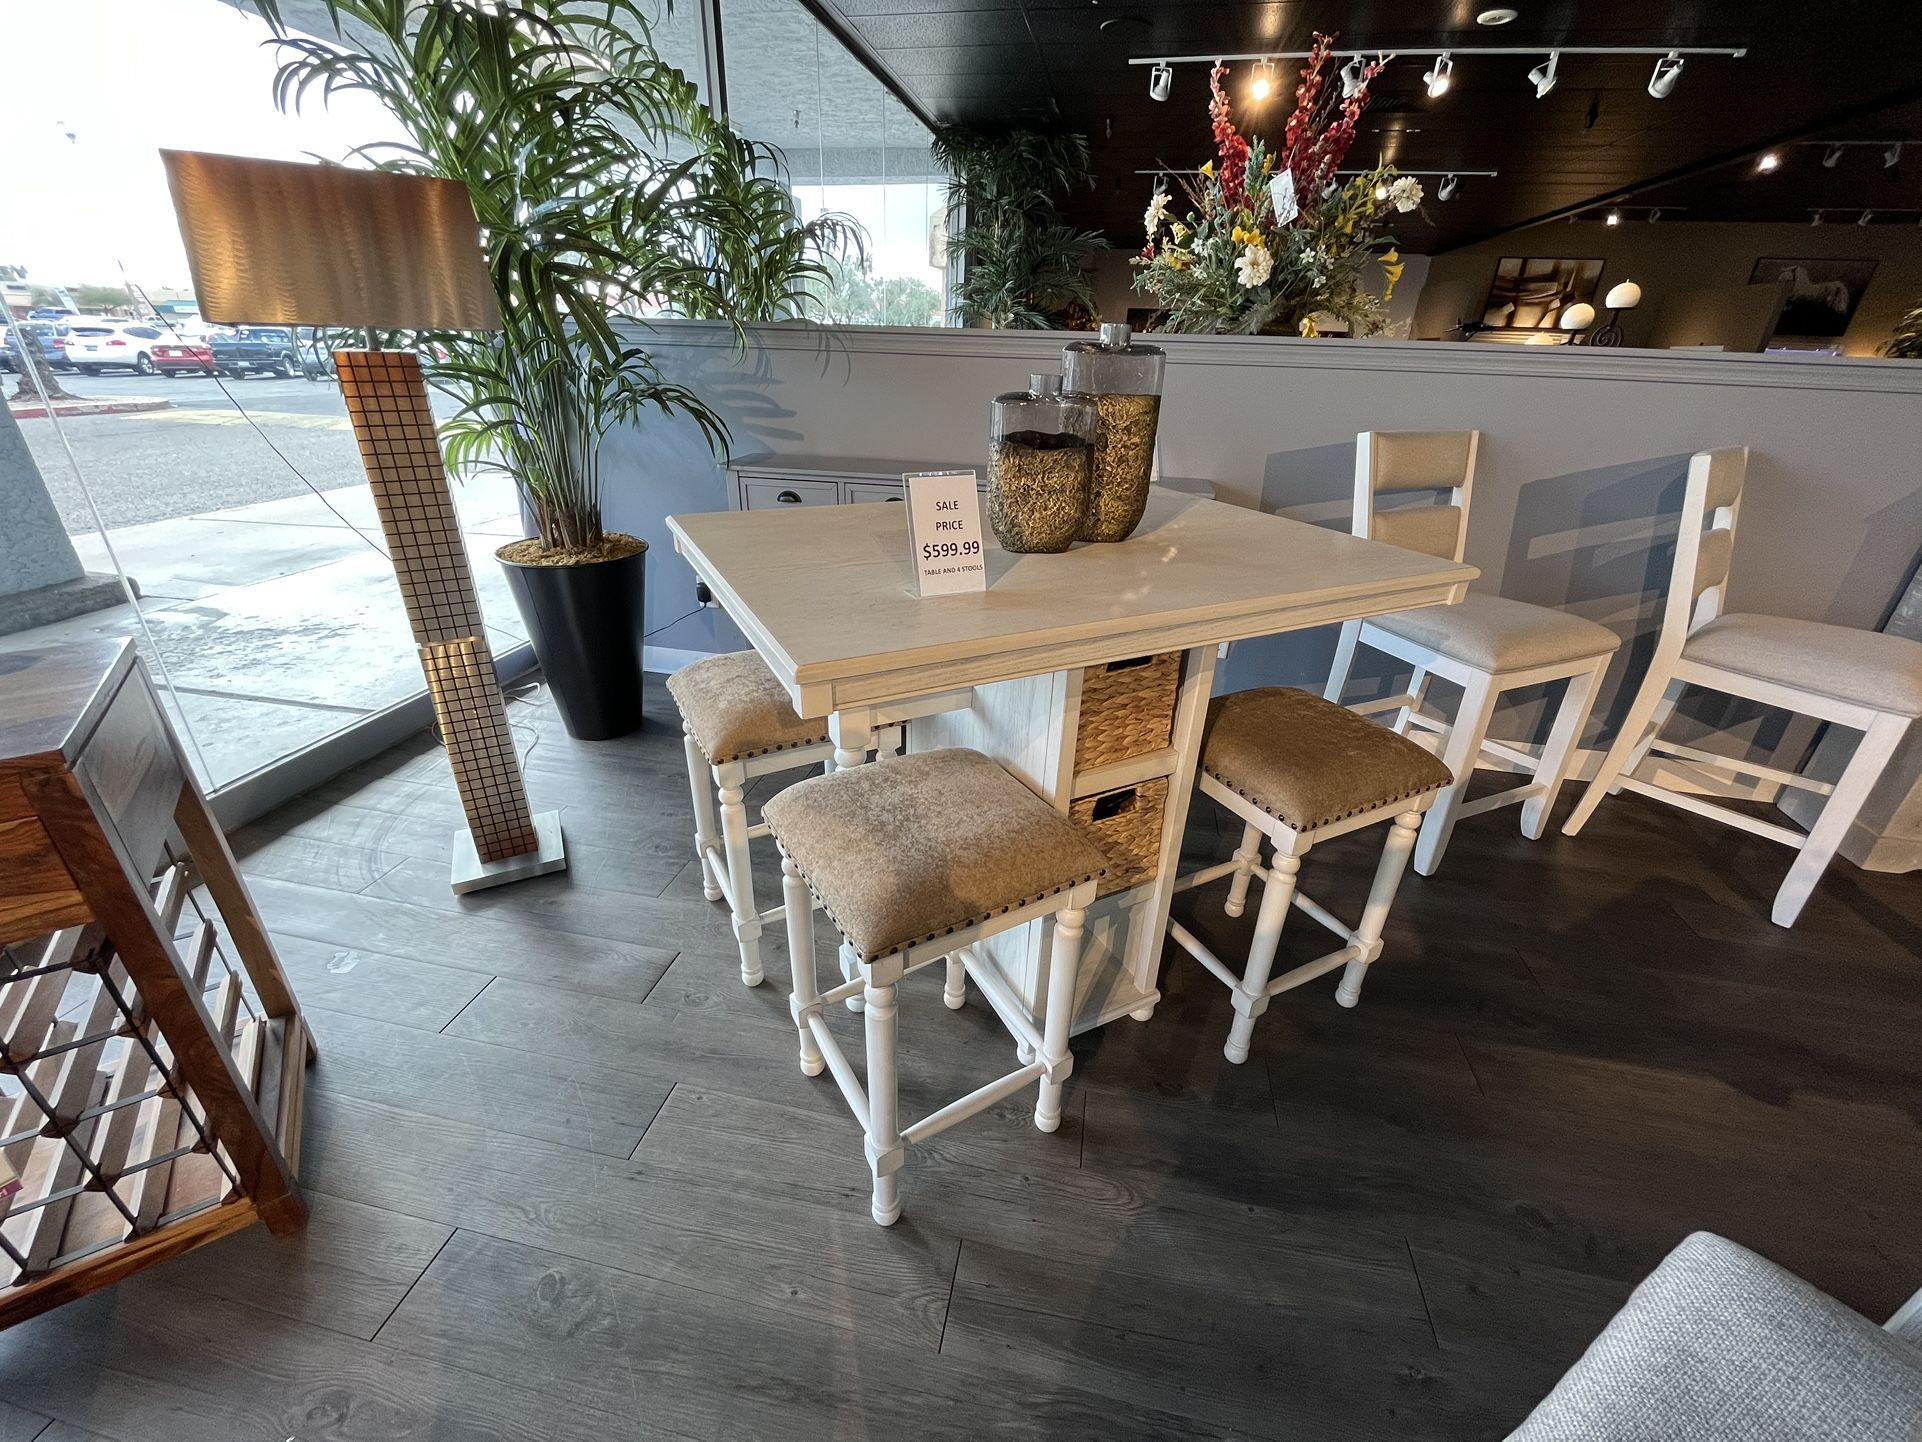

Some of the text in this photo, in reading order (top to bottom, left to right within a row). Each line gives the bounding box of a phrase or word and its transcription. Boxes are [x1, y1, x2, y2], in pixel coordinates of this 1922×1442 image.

[935, 500, 959, 511] SALE
[935, 520, 964, 531] PRICE
[922, 540, 980, 561] $599.99
[924, 568, 942, 576] TABLE
[961, 564, 983, 572] STOOLS
